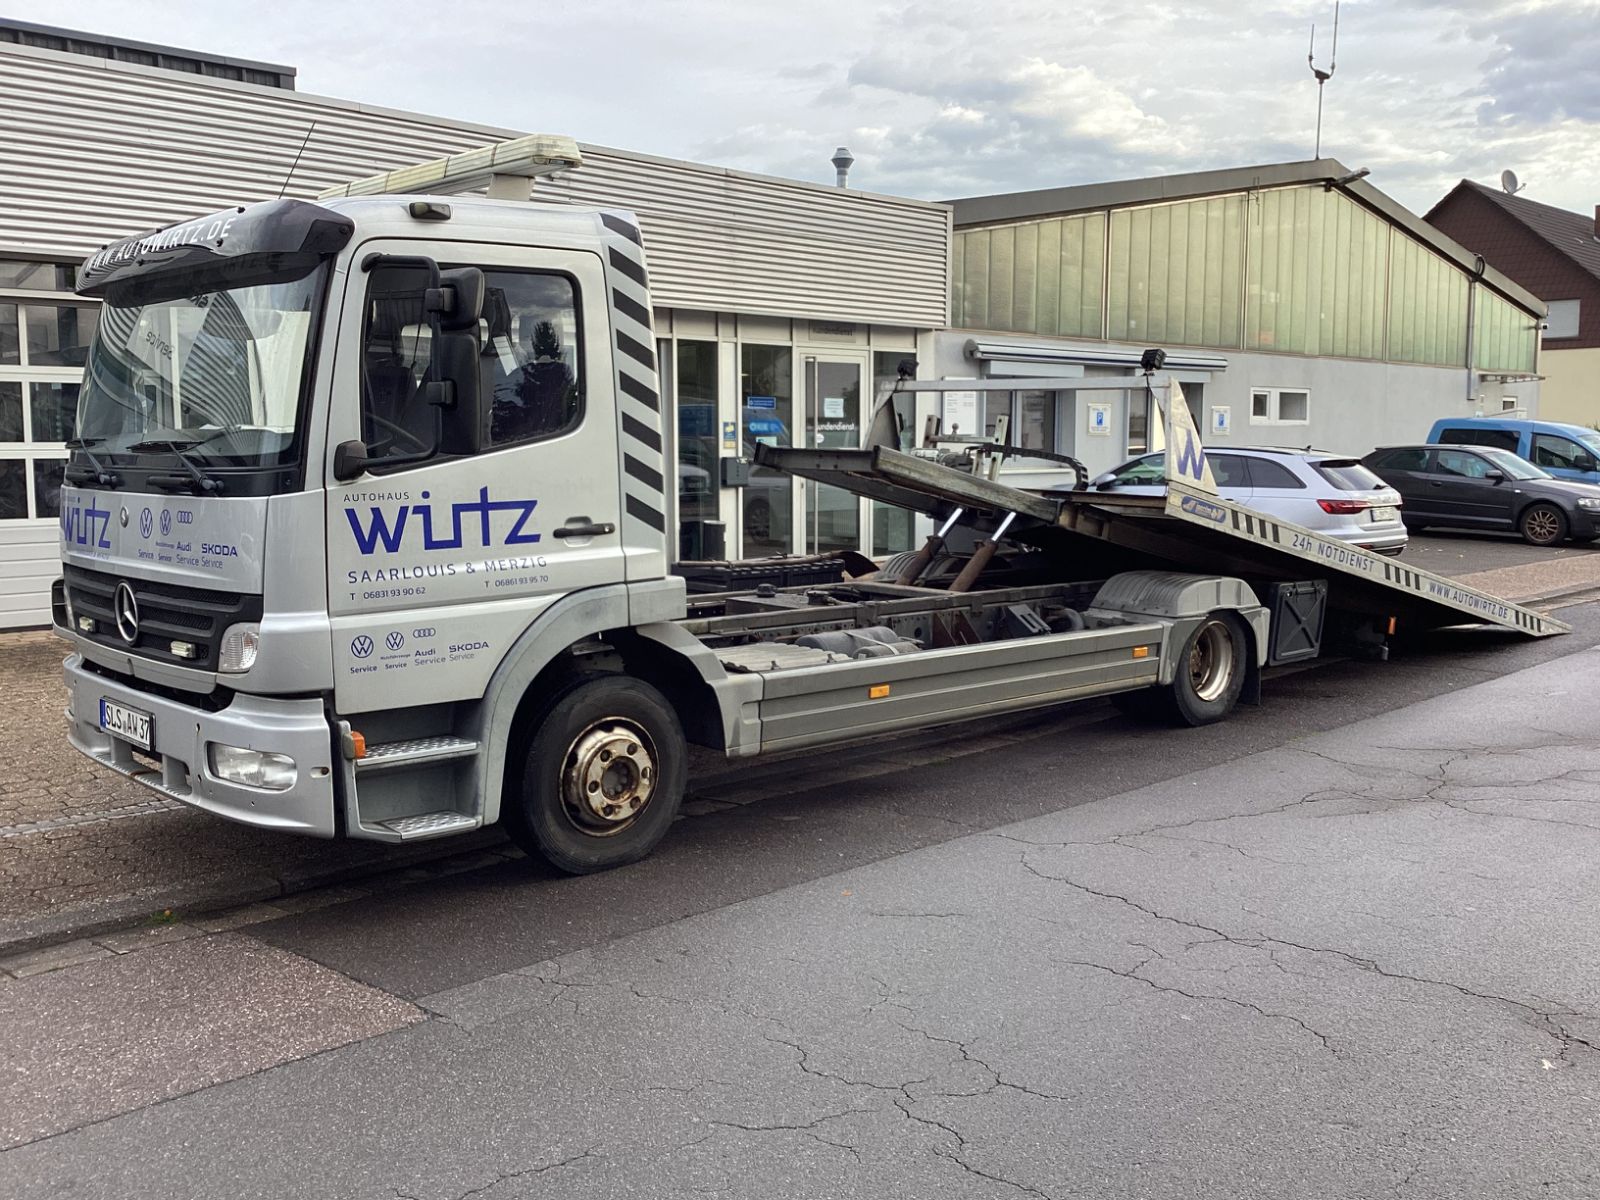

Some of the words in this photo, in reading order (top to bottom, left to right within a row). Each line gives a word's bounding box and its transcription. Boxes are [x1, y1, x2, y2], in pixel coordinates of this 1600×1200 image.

[344, 491, 410, 502] AUTOHAUS
[176, 541, 192, 552] Audi
[138, 549, 154, 559] Service
[1292, 534, 1312, 552] 24h
[1318, 542, 1375, 572] NOTDIENST
[176, 554, 199, 566] Service
[201, 556, 223, 569] Service
[348, 563, 456, 584] SAARLOUIS
[466, 562, 476, 574] &
[484, 556, 547, 572] MERZIG
[484, 580, 490, 588] T
[350, 592, 356, 600] T
[1429, 581, 1508, 619] WWW.AUTOWIRTZ.DE
[414, 648, 436, 657] Audi
[449, 653, 475, 662] Service
[385, 662, 408, 670] Service
[414, 657, 446, 666] Service
[350, 665, 377, 674] Service
[106, 705, 122, 730] SLS
